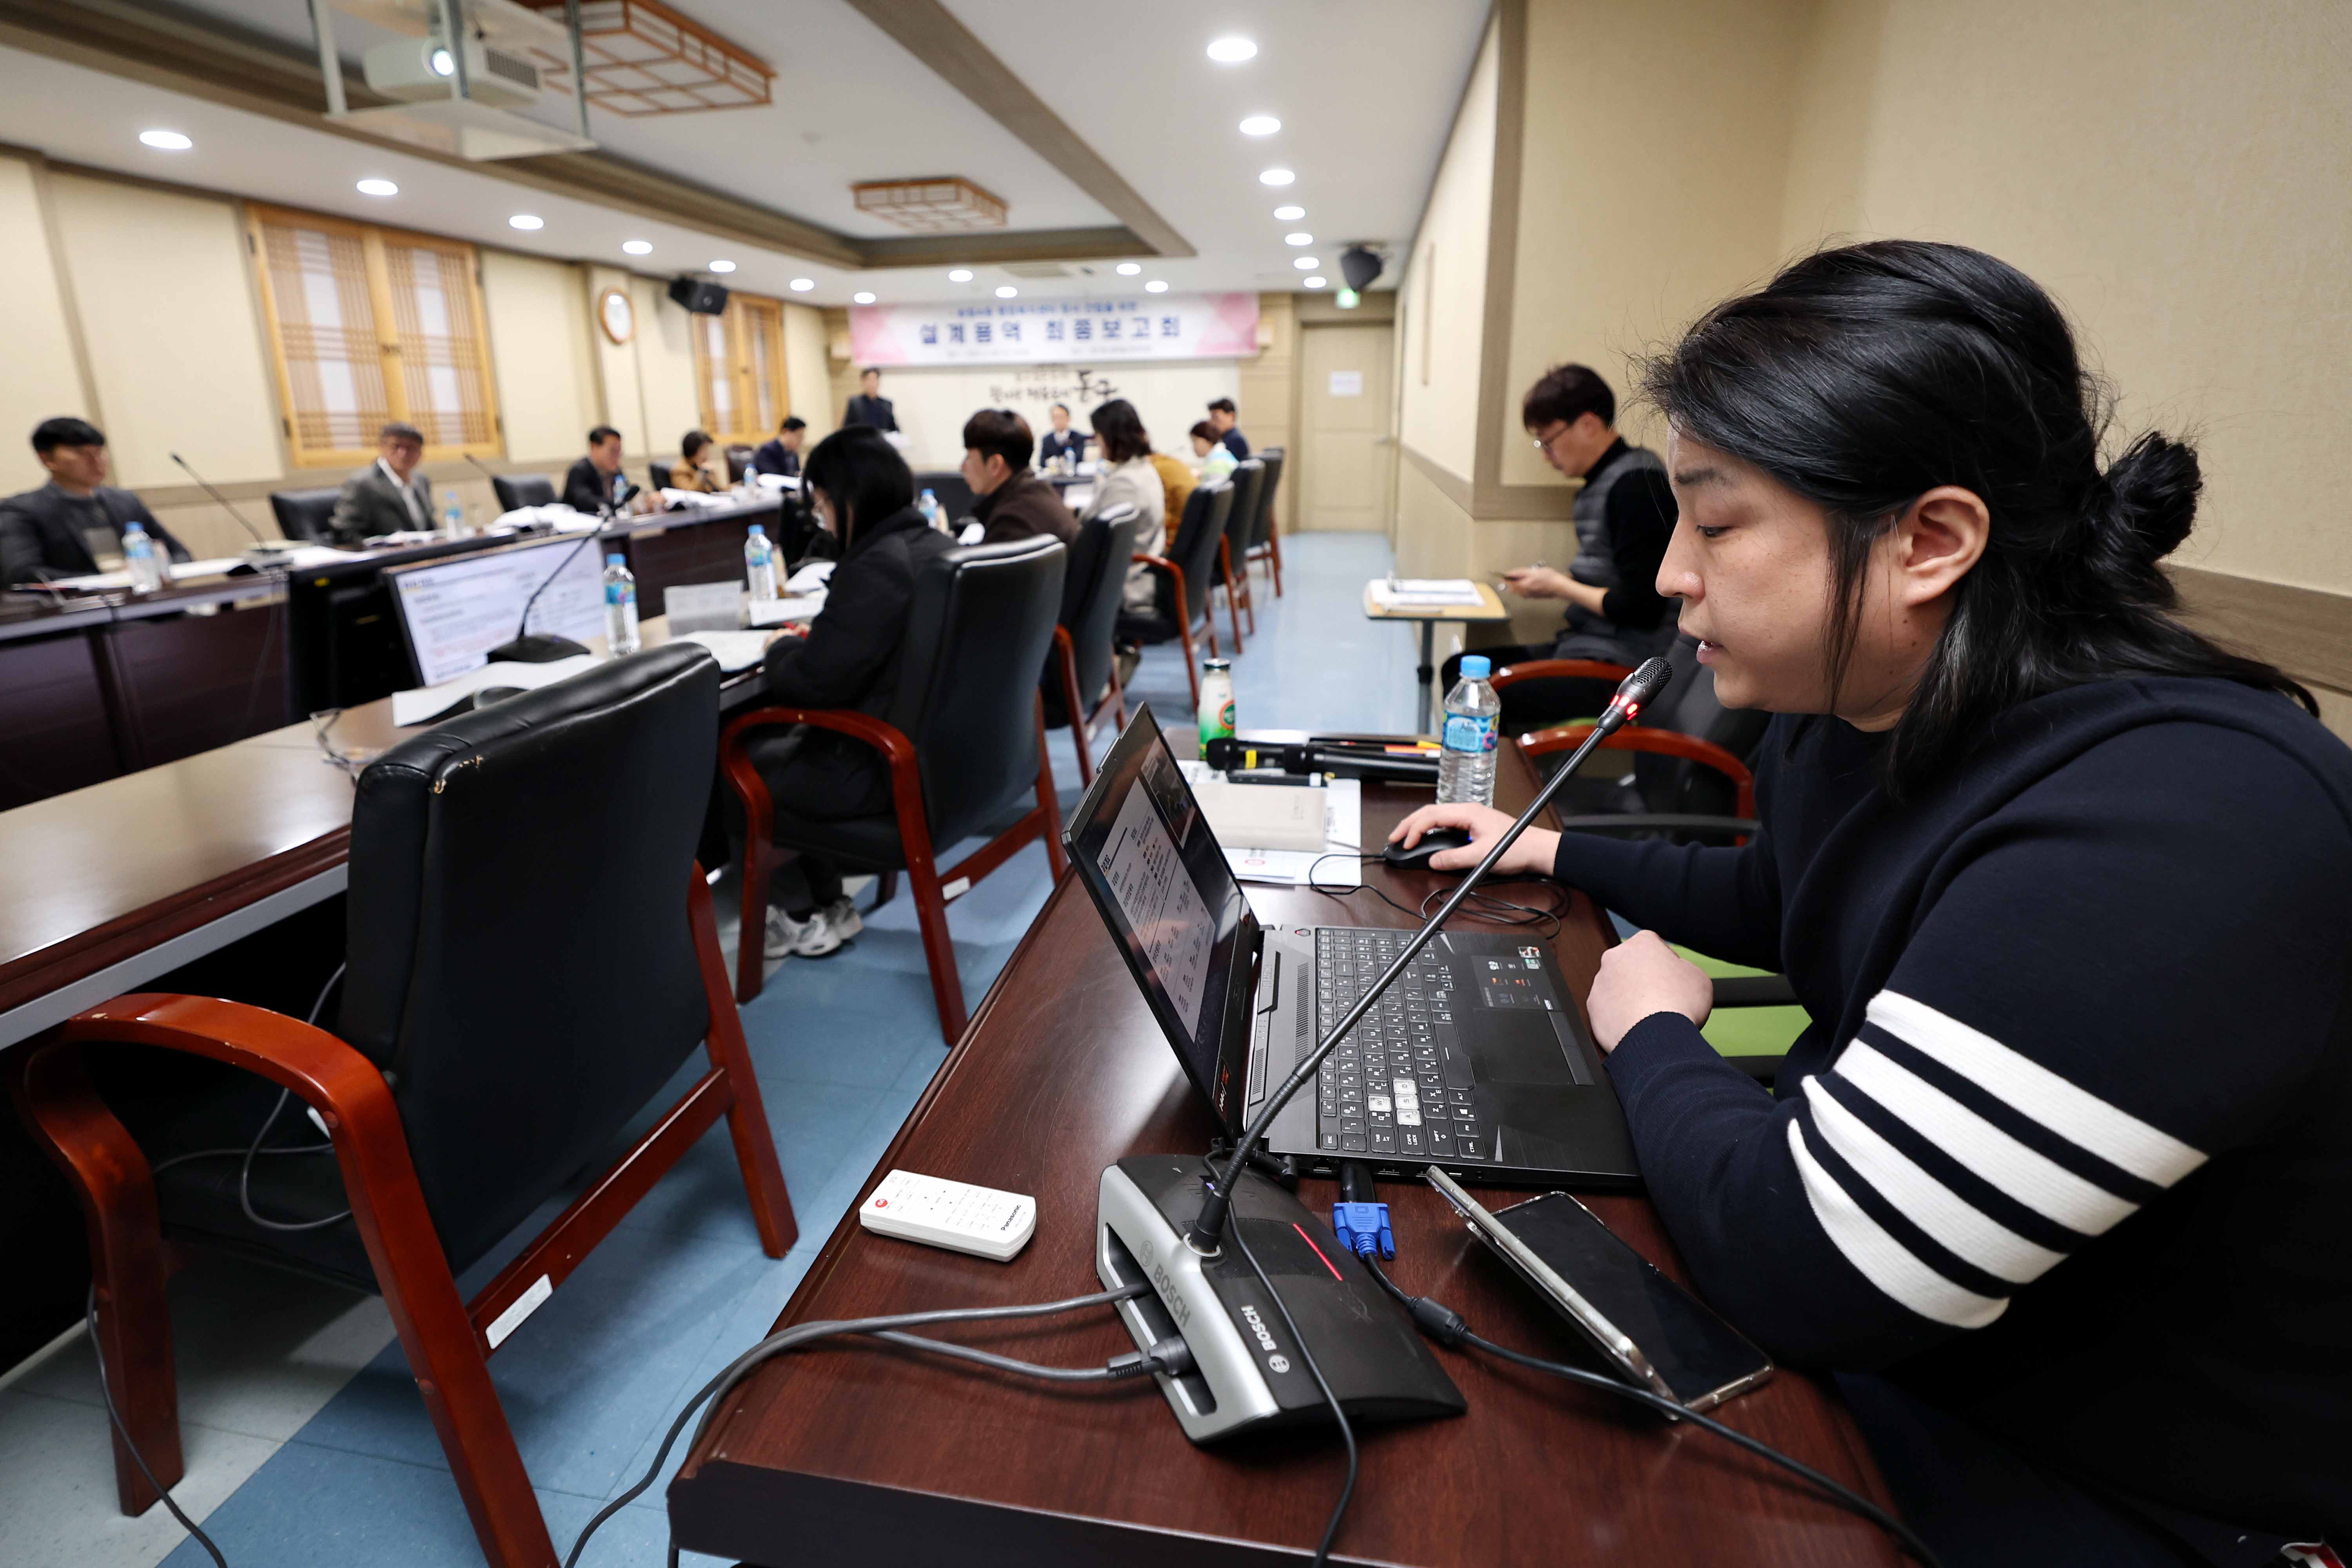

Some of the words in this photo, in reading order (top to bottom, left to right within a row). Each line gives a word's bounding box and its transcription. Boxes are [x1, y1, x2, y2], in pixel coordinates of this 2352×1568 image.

[920, 322, 1022, 344] 설계용역
[1047, 316, 1180, 340] 최종보고회
[1000, 1205, 1021, 1231] Panasonic
[1154, 1263, 1191, 1327] BOSCH
[1241, 1305, 1276, 1351] BOSCH
